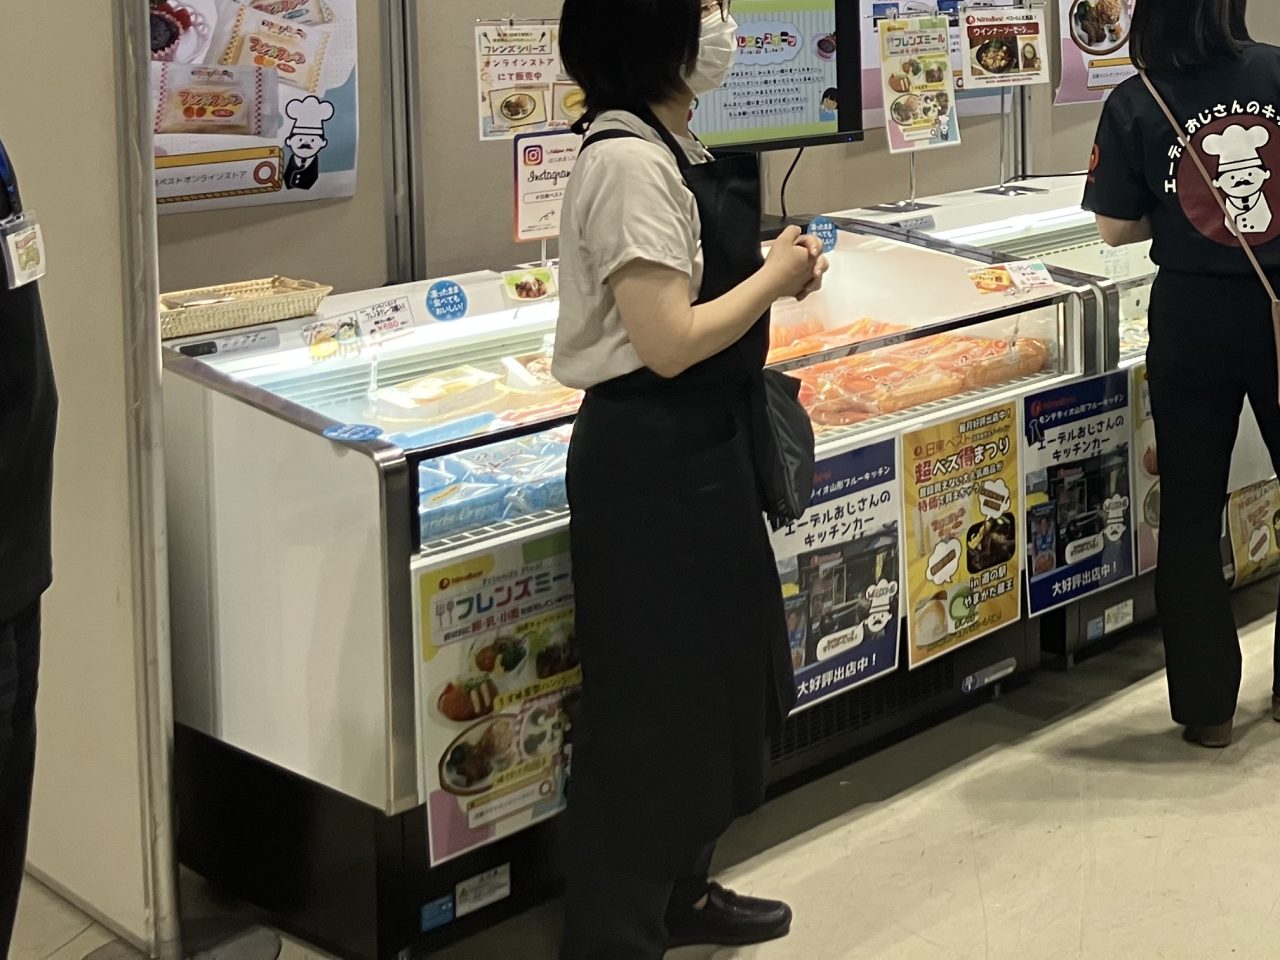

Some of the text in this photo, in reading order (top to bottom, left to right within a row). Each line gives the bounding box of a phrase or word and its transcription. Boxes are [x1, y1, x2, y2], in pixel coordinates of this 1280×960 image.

[484, 44, 547, 53] フレンズシリーズ
[484, 58, 554, 67] オンラインストア
[498, 72, 542, 80] にて販売中
[155, 171, 247, 186] ベストオンラインストア
[1037, 415, 1124, 451] エーテルおじさんの
[915, 435, 1010, 485] 超ベス得まつり
[1052, 437, 1110, 461] キッチンカー
[785, 490, 891, 536] エーテルおじさんの
[804, 517, 875, 547] キッチンカー
